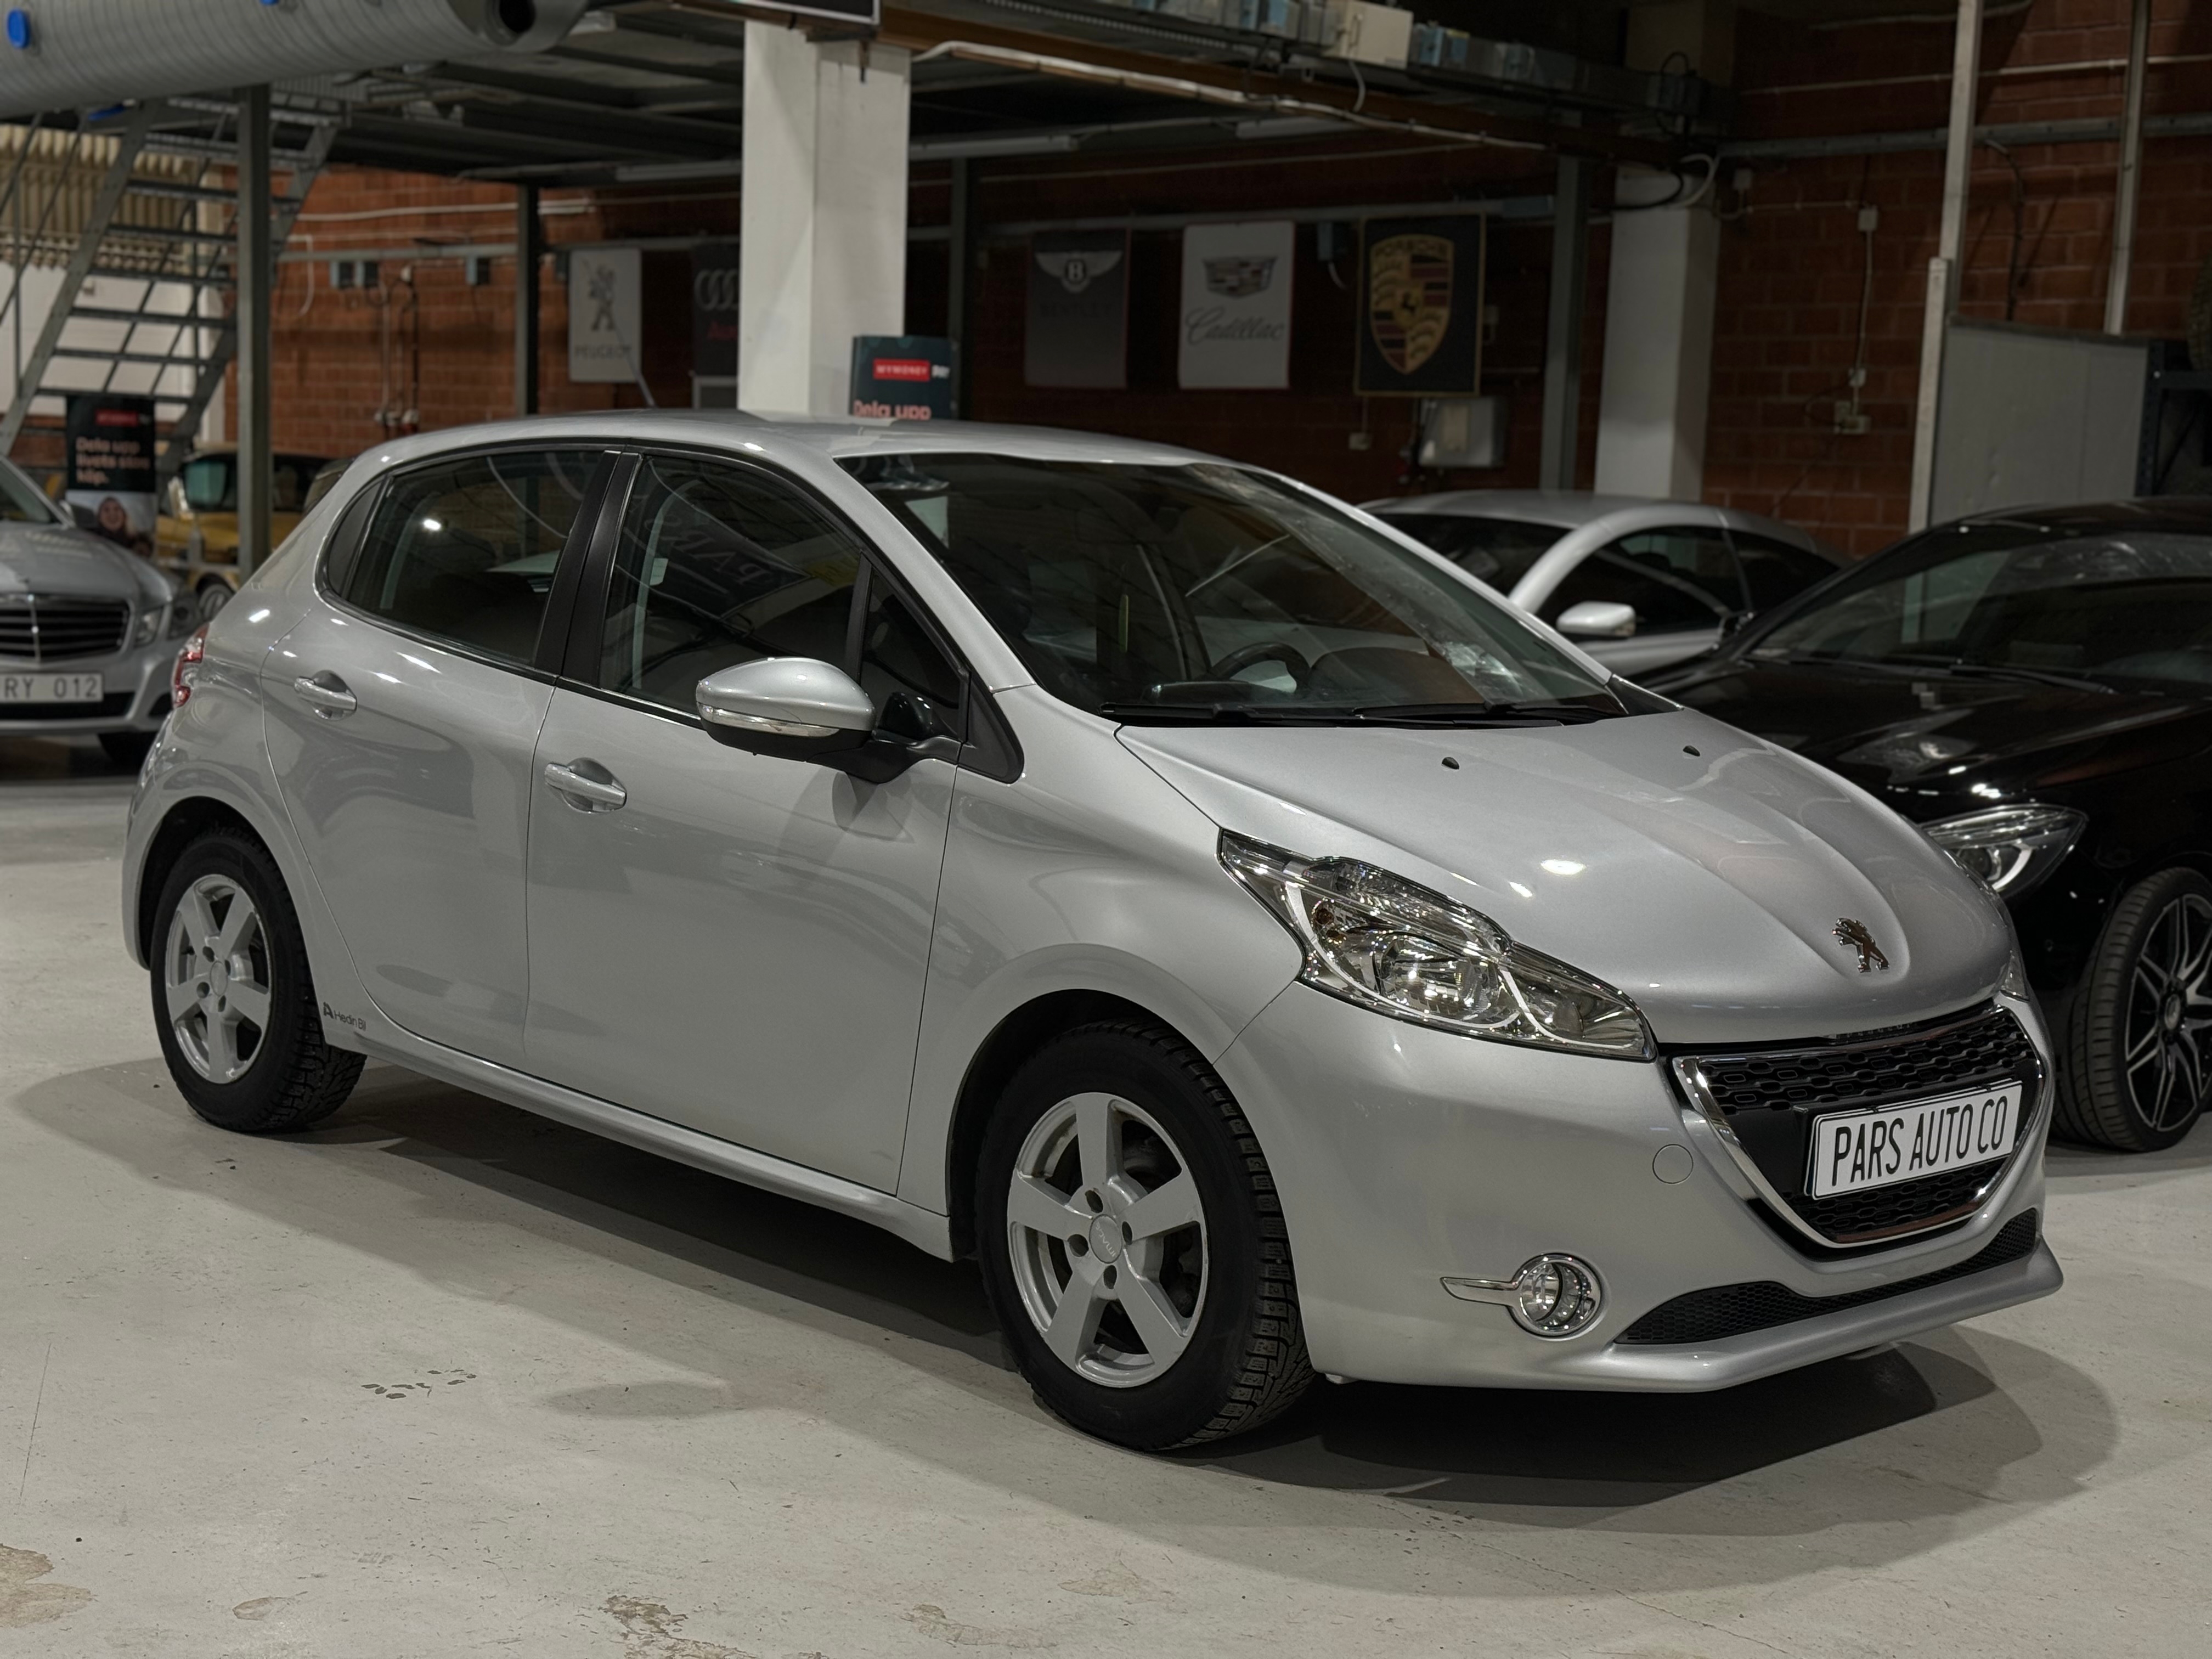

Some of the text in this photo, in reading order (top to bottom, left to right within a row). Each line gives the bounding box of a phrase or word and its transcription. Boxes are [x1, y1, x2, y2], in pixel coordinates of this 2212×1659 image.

[1185, 305, 1285, 346] Cadillac
[53, 676, 98, 698] 012
[334, 1011, 358, 1026] Hedin
[1831, 1096, 2008, 1187] PARS AUTO CO
